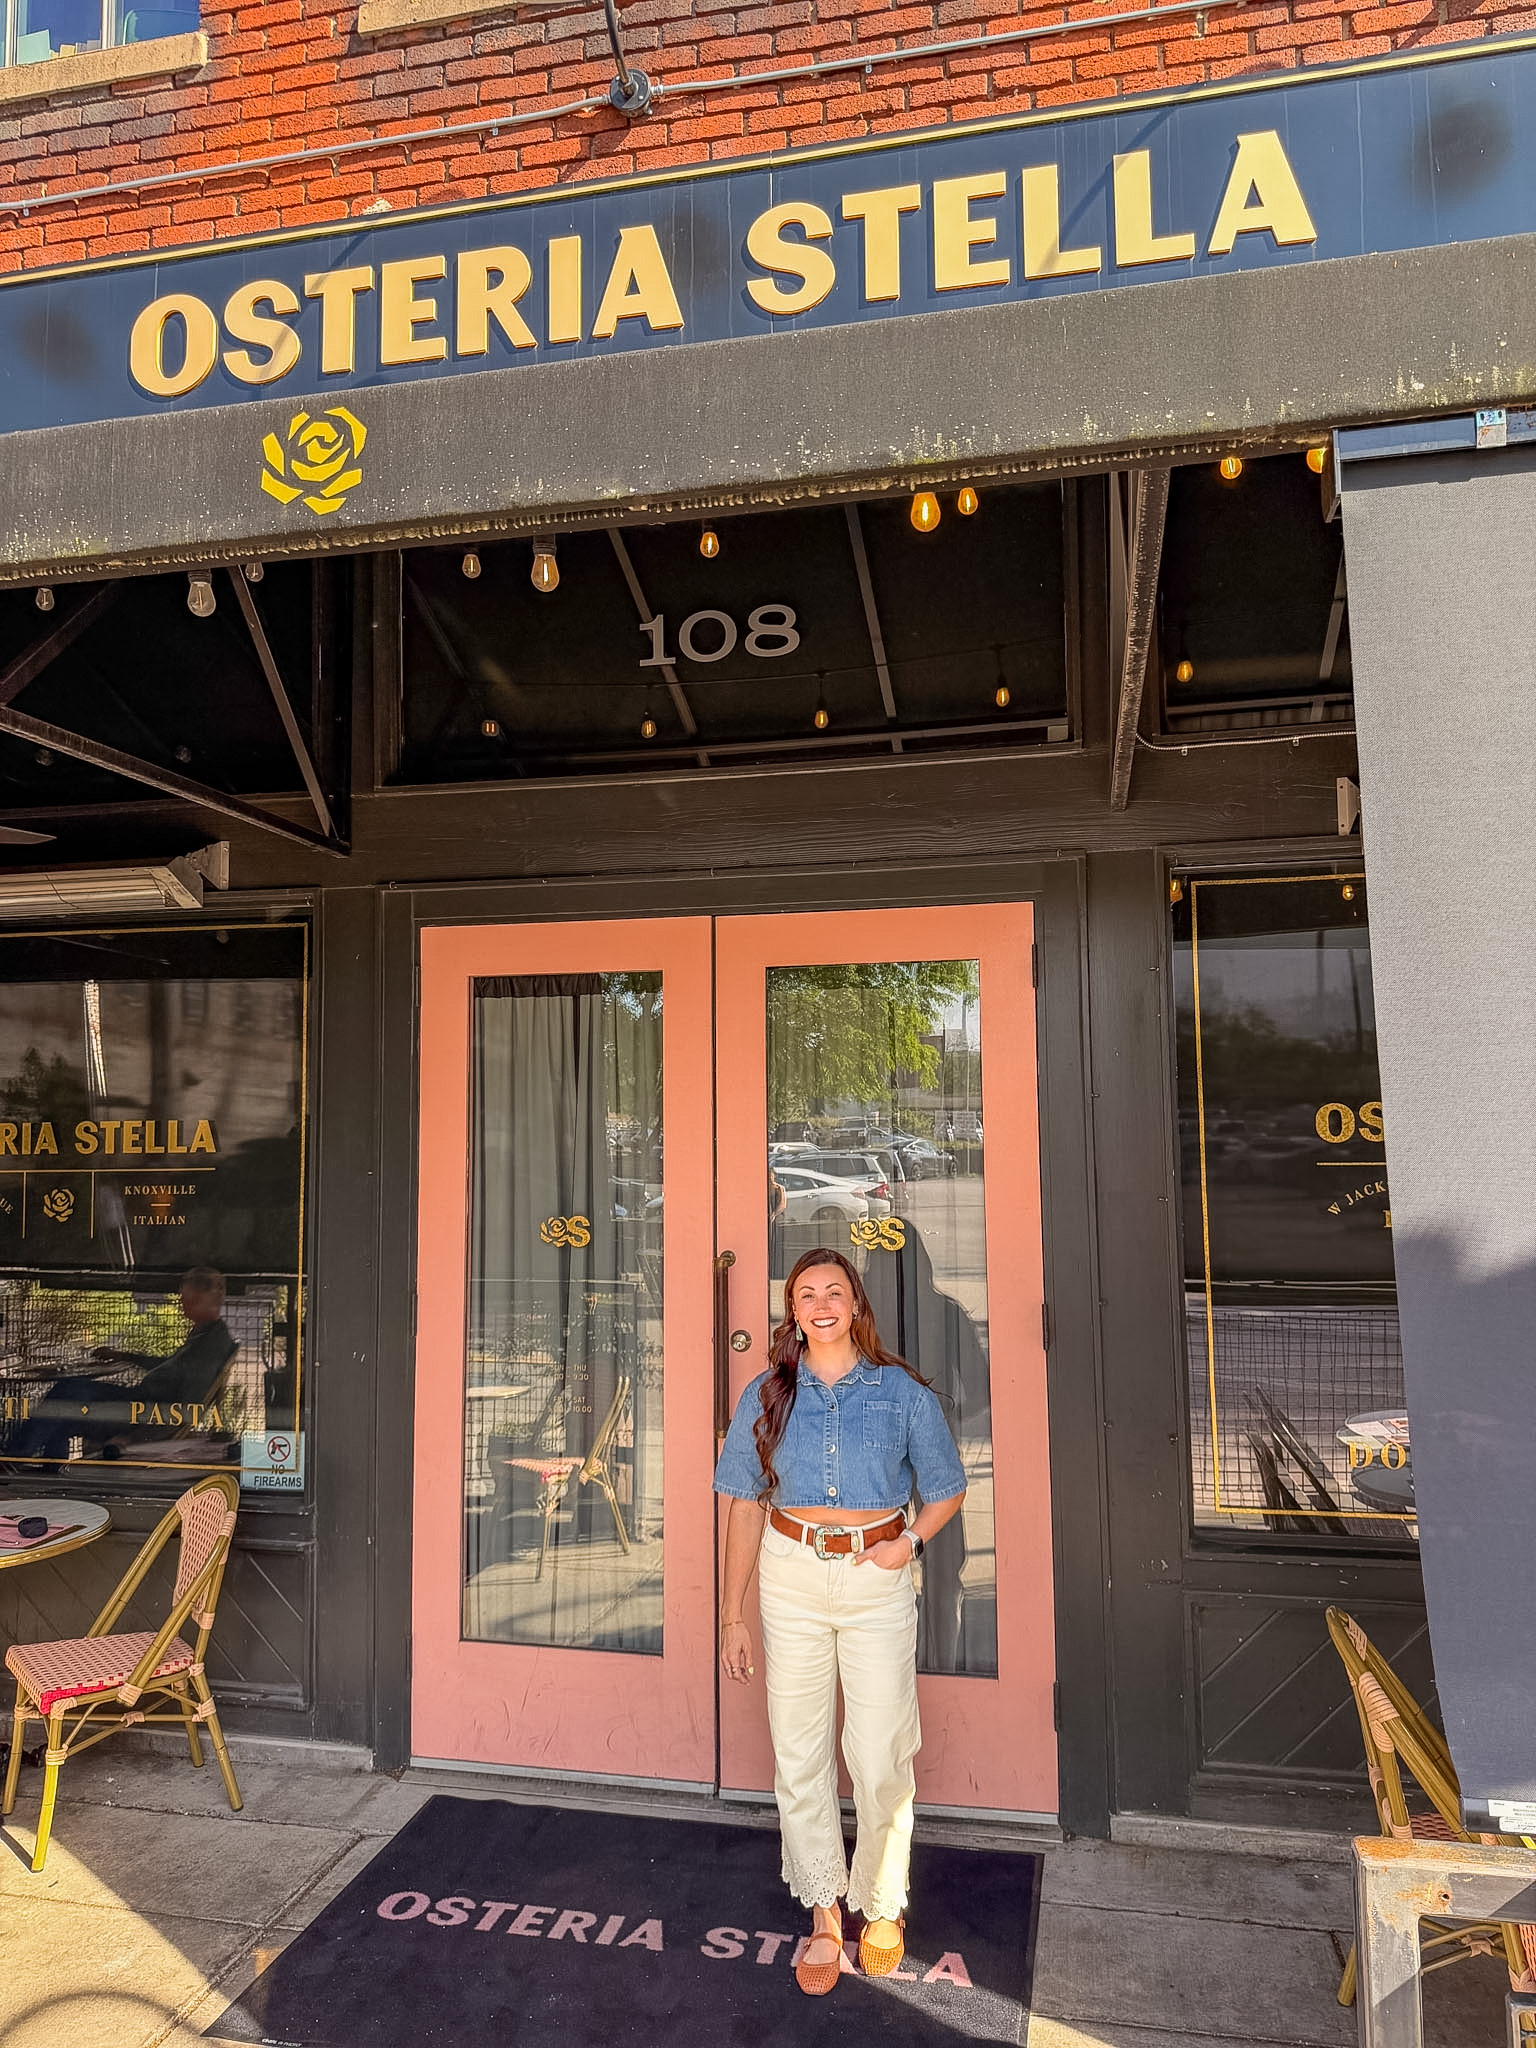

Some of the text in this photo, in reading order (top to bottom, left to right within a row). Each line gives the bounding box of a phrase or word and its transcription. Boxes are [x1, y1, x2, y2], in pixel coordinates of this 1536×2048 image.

[130, 129, 1317, 396] OSTERIA STELLA
[639, 604, 800, 667] 108
[0, 1120, 217, 1155] RIA STELLA
[124, 1184, 196, 1195] KNOXVILLE
[1327, 1181, 1386, 1215] W JACK
[133, 1215, 186, 1225] ITALIAN
[573, 1364, 587, 1372] THU
[129, 1401, 223, 1428] PASTA
[271, 1464, 285, 1475] NO
[1349, 1441, 1407, 1470] DO
[254, 1476, 302, 1488] FIREARMS
[376, 1891, 664, 1951] OSTERIA
